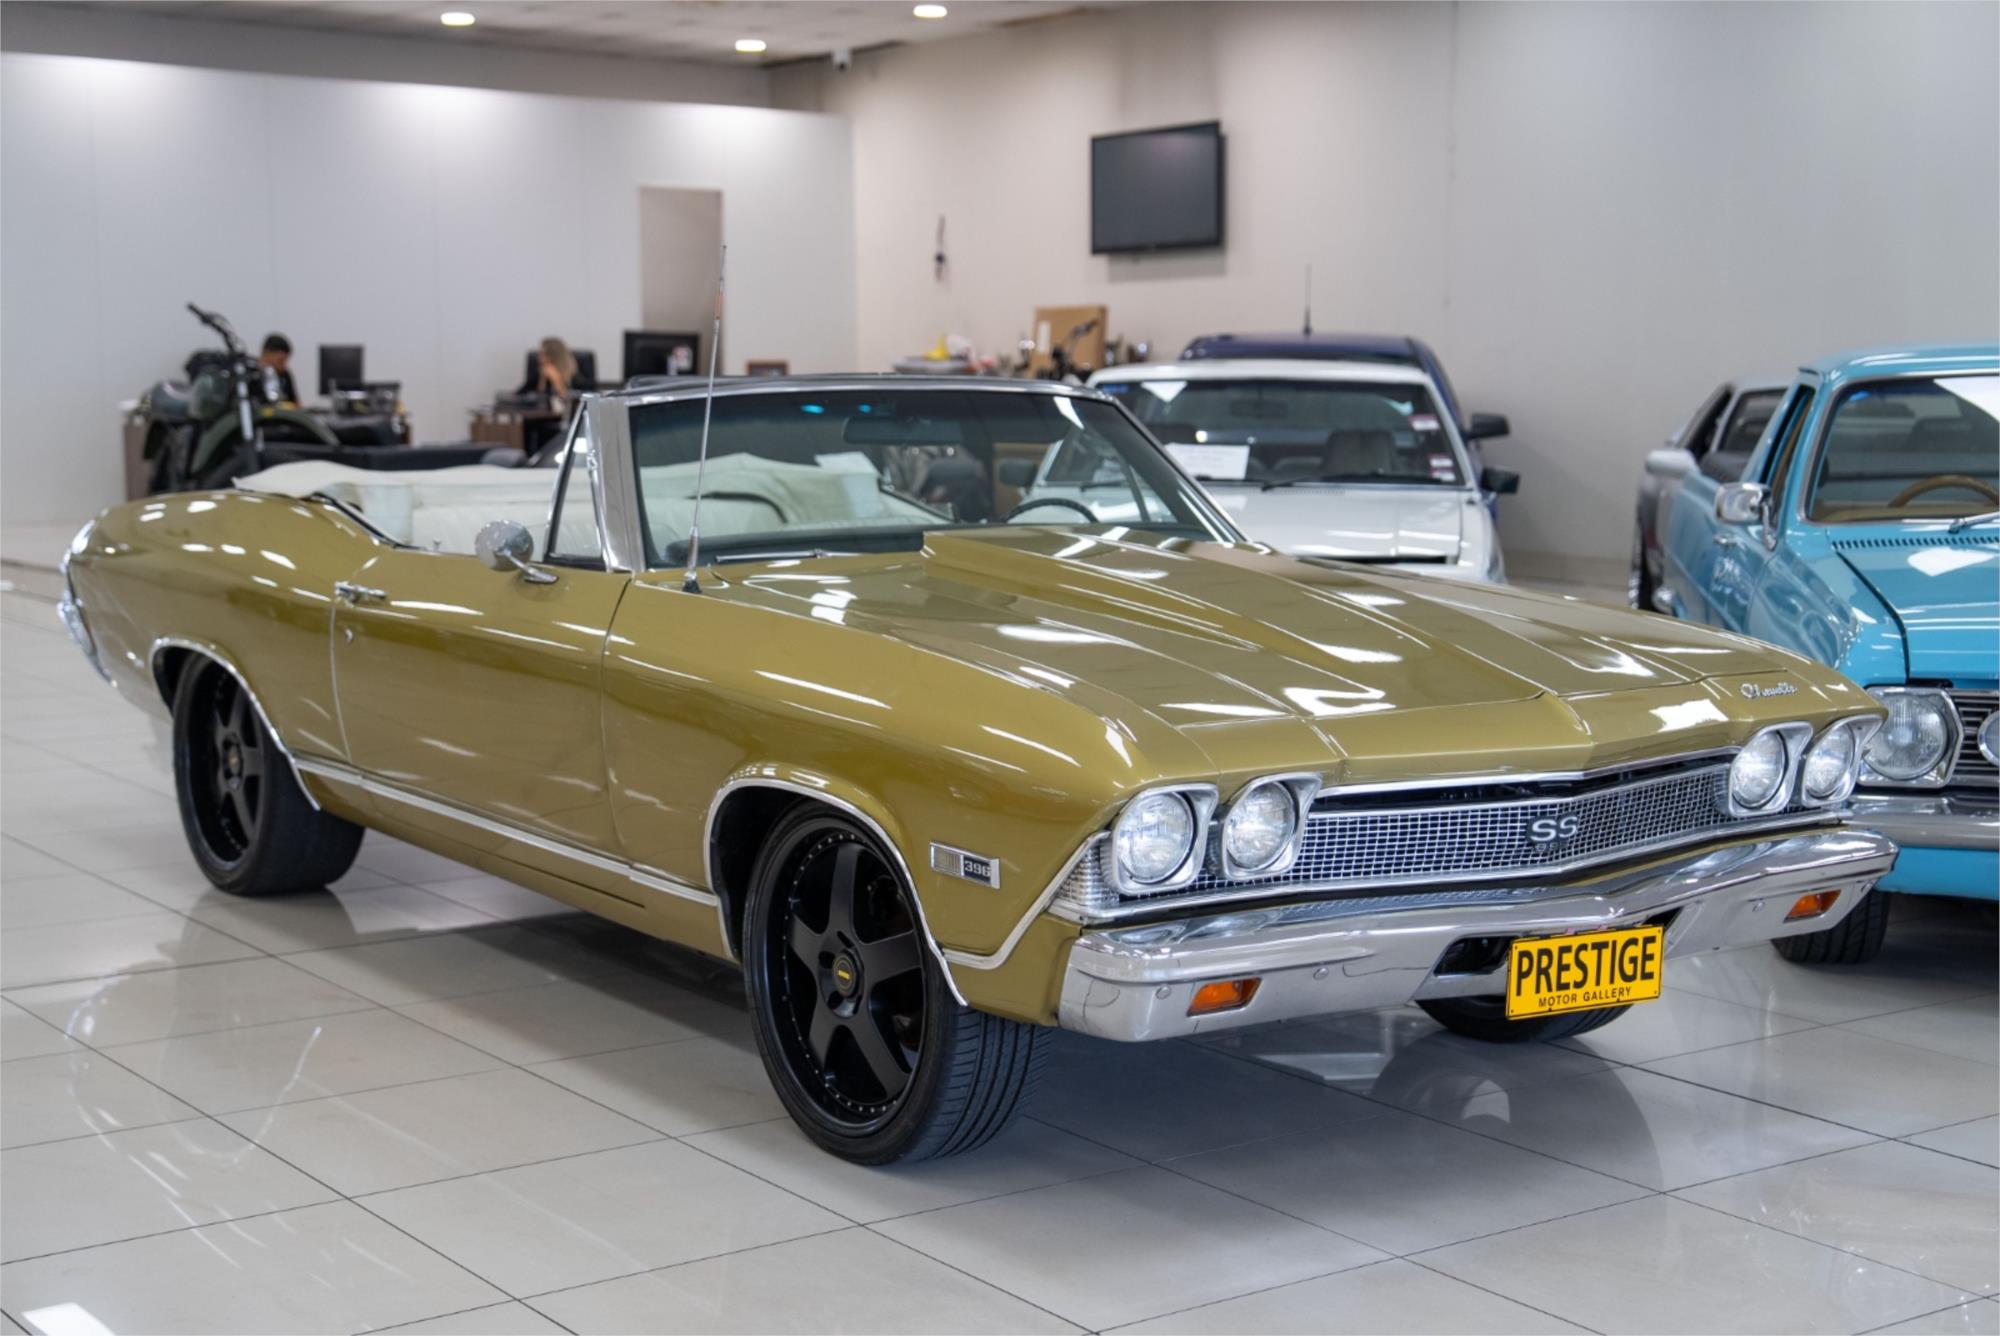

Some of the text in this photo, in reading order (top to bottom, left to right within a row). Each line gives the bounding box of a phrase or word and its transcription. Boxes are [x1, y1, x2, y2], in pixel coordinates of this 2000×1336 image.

[1530, 816, 1578, 842] SS
[964, 860, 991, 877] 396
[1516, 936, 1656, 997] PRESTIGE
[1538, 986, 1631, 1008] MOTOR GALLERY
